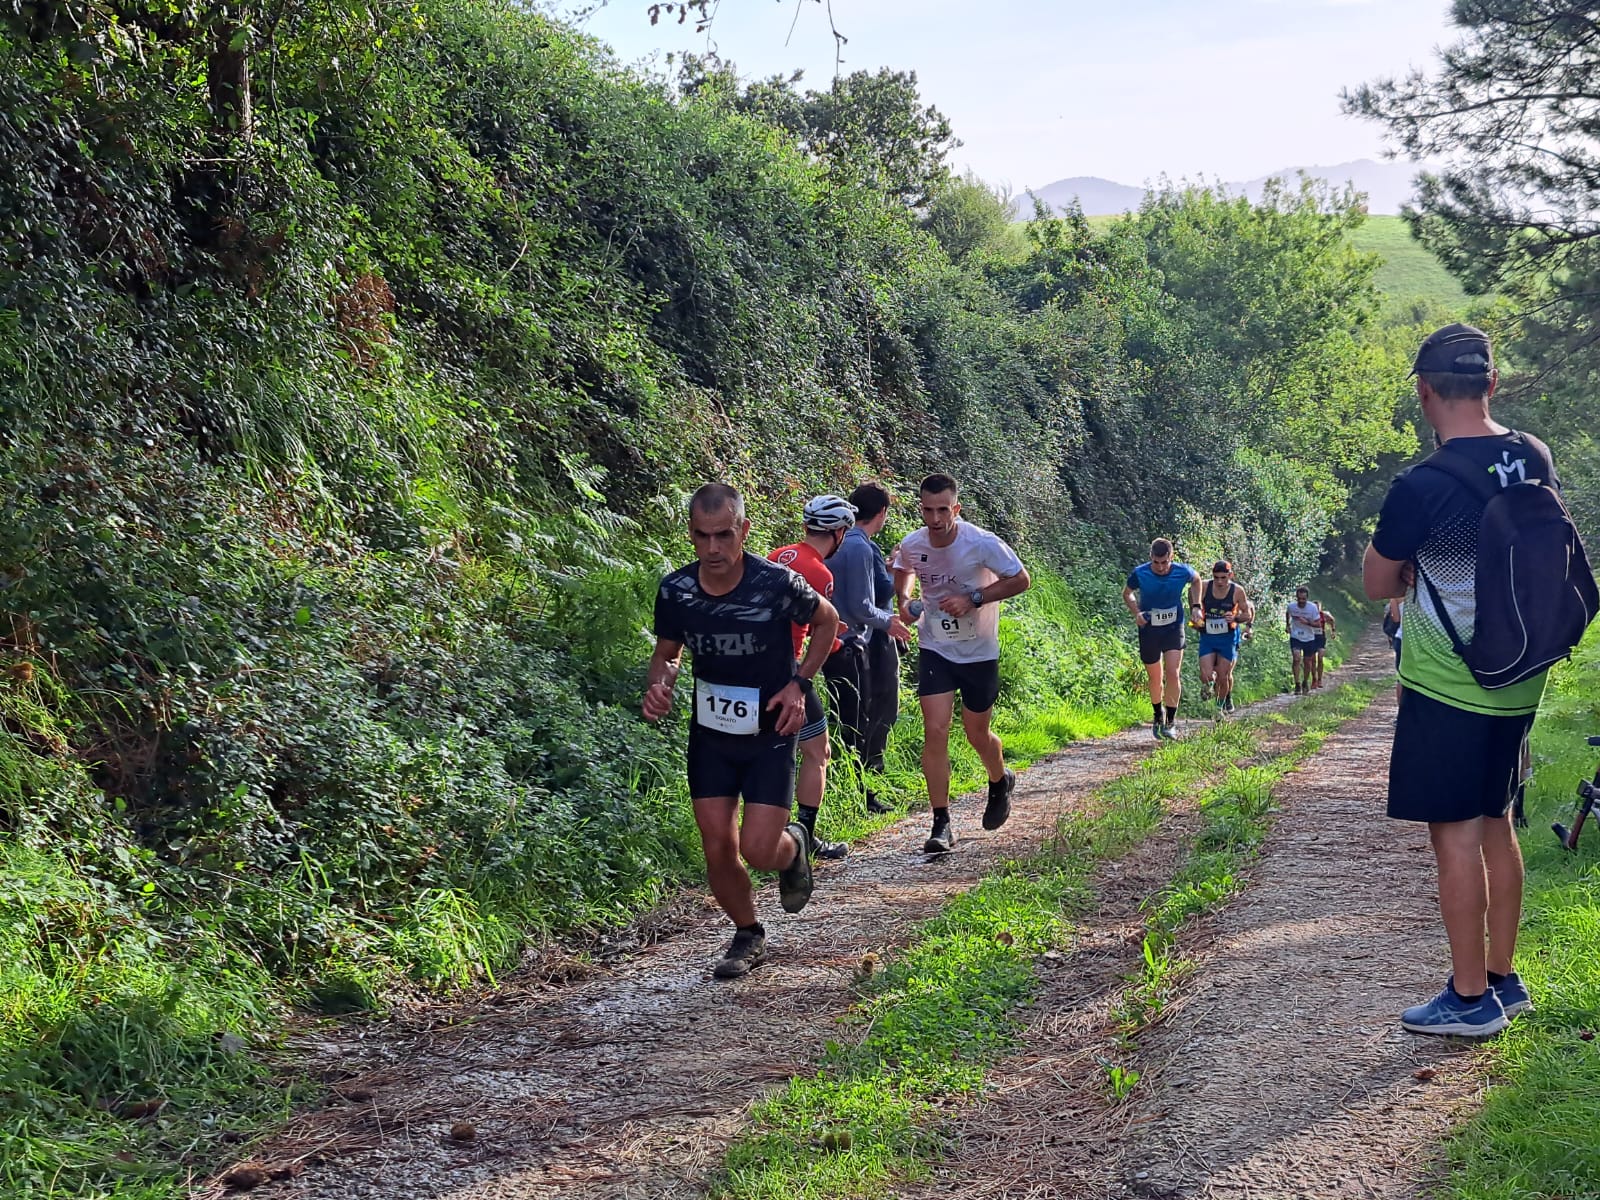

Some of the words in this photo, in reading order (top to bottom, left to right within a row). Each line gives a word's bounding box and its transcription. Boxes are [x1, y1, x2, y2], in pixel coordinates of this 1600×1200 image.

[1156, 612, 1173, 621] 189
[942, 618, 960, 630] 61
[706, 695, 748, 719] 176
